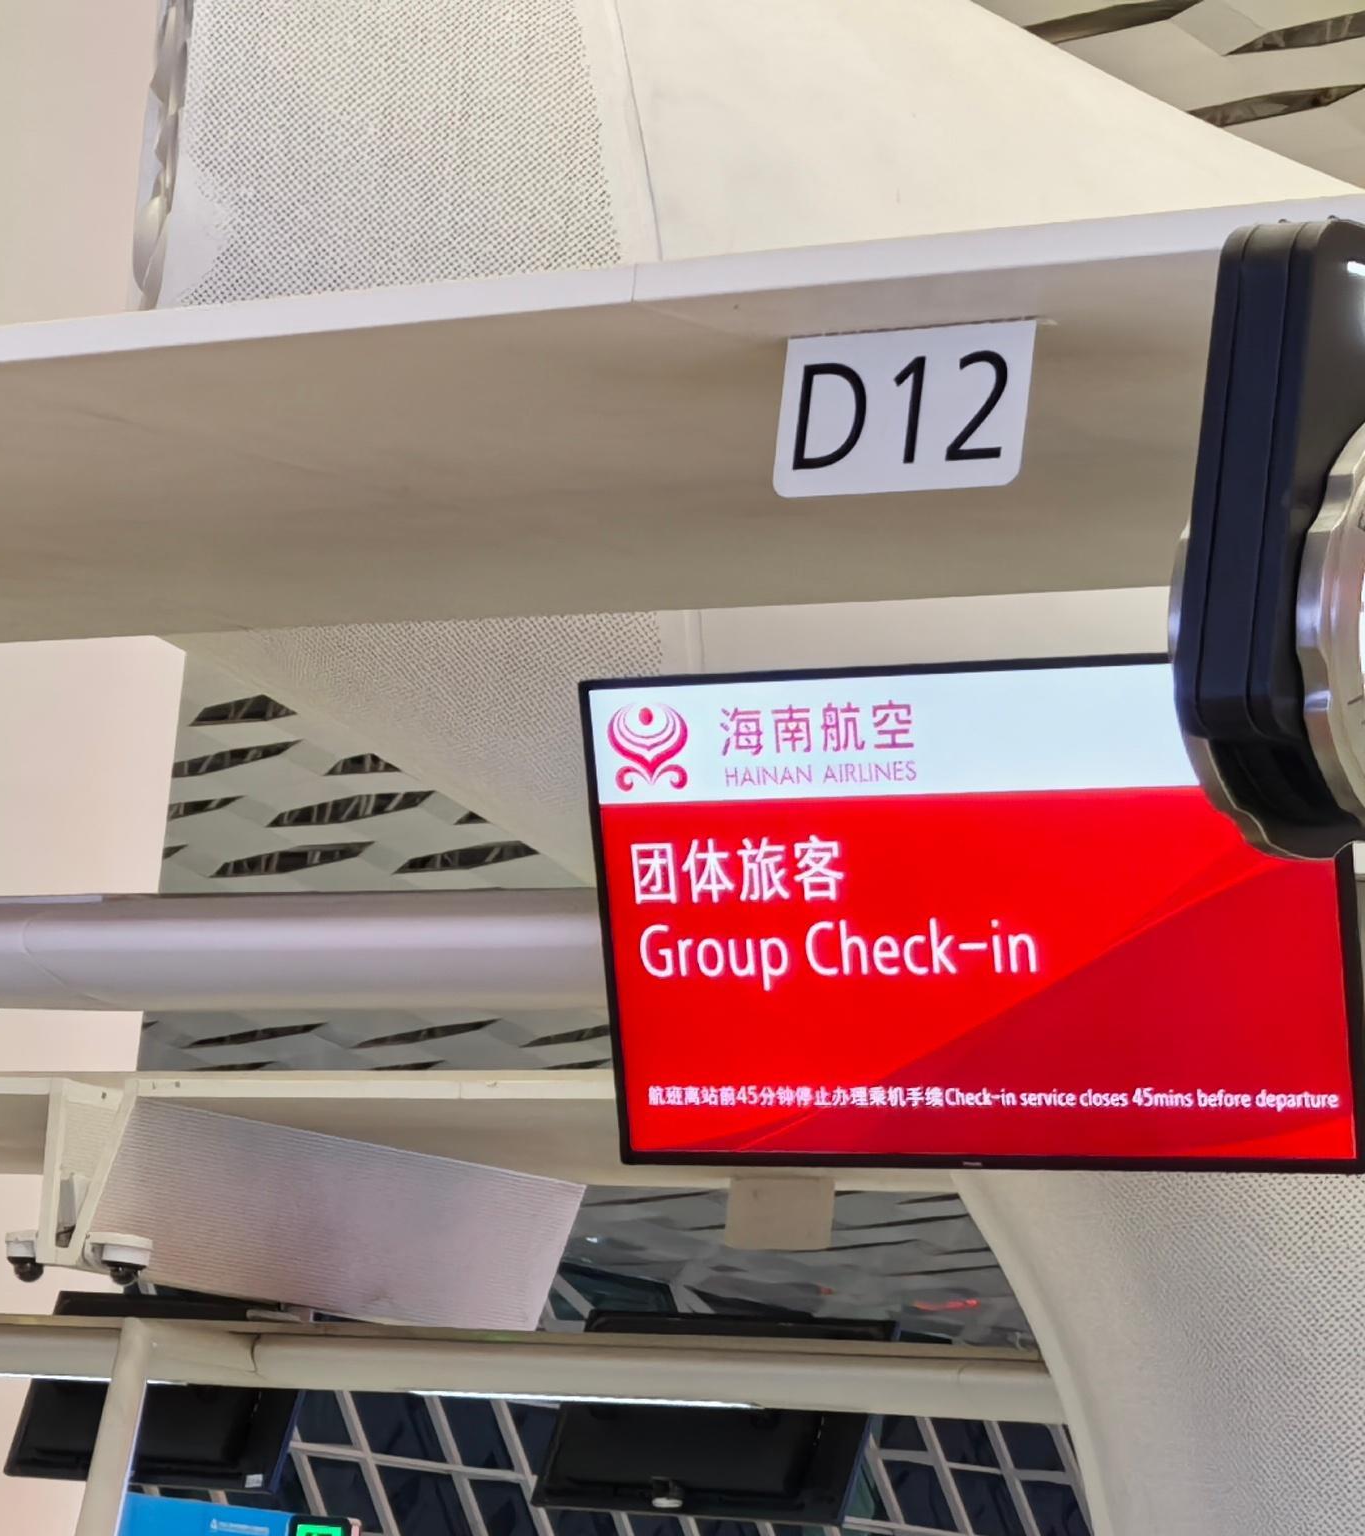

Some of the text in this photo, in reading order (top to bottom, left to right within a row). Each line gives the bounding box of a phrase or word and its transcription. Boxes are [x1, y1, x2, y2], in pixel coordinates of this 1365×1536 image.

[792, 351, 1009, 471] D12
[720, 700, 916, 756] 海南航空
[725, 761, 917, 787] HAINAN AIRLINES
[630, 835, 845, 904] 团体旅客
[639, 917, 1039, 991] Group Check-in
[945, 1086, 1017, 1108] Check-in
[1020, 1088, 1076, 1108] service
[1080, 1088, 1129, 1108] closes
[1132, 1088, 1194, 1109] 45mins
[1197, 1089, 1252, 1110] before
[1254, 1089, 1341, 1113] departure
